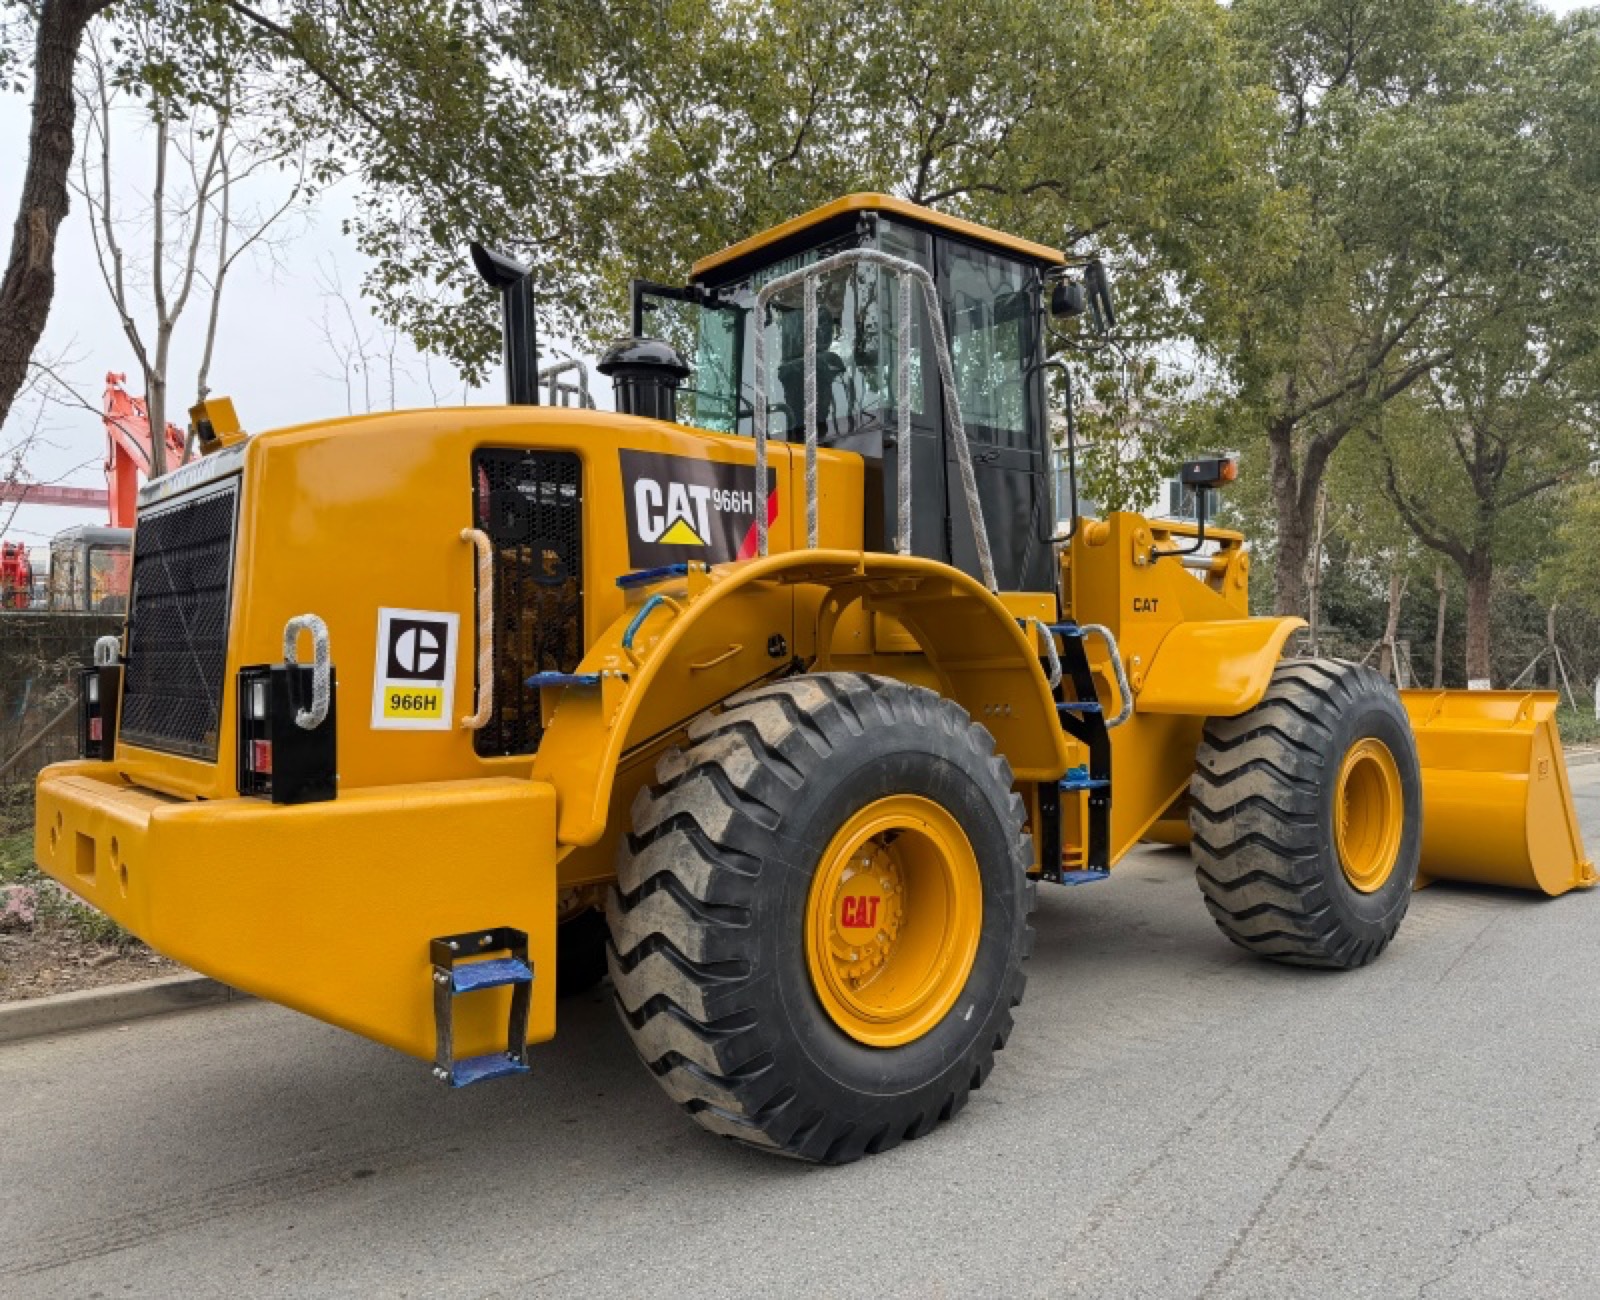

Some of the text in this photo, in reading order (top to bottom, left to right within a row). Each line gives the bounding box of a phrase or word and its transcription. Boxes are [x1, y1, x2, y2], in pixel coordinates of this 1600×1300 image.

[634, 477, 753, 546] CAT 966H
[1133, 597, 1159, 613] CAT
[390, 693, 437, 711] 966H
[842, 895, 881, 928] CAT
